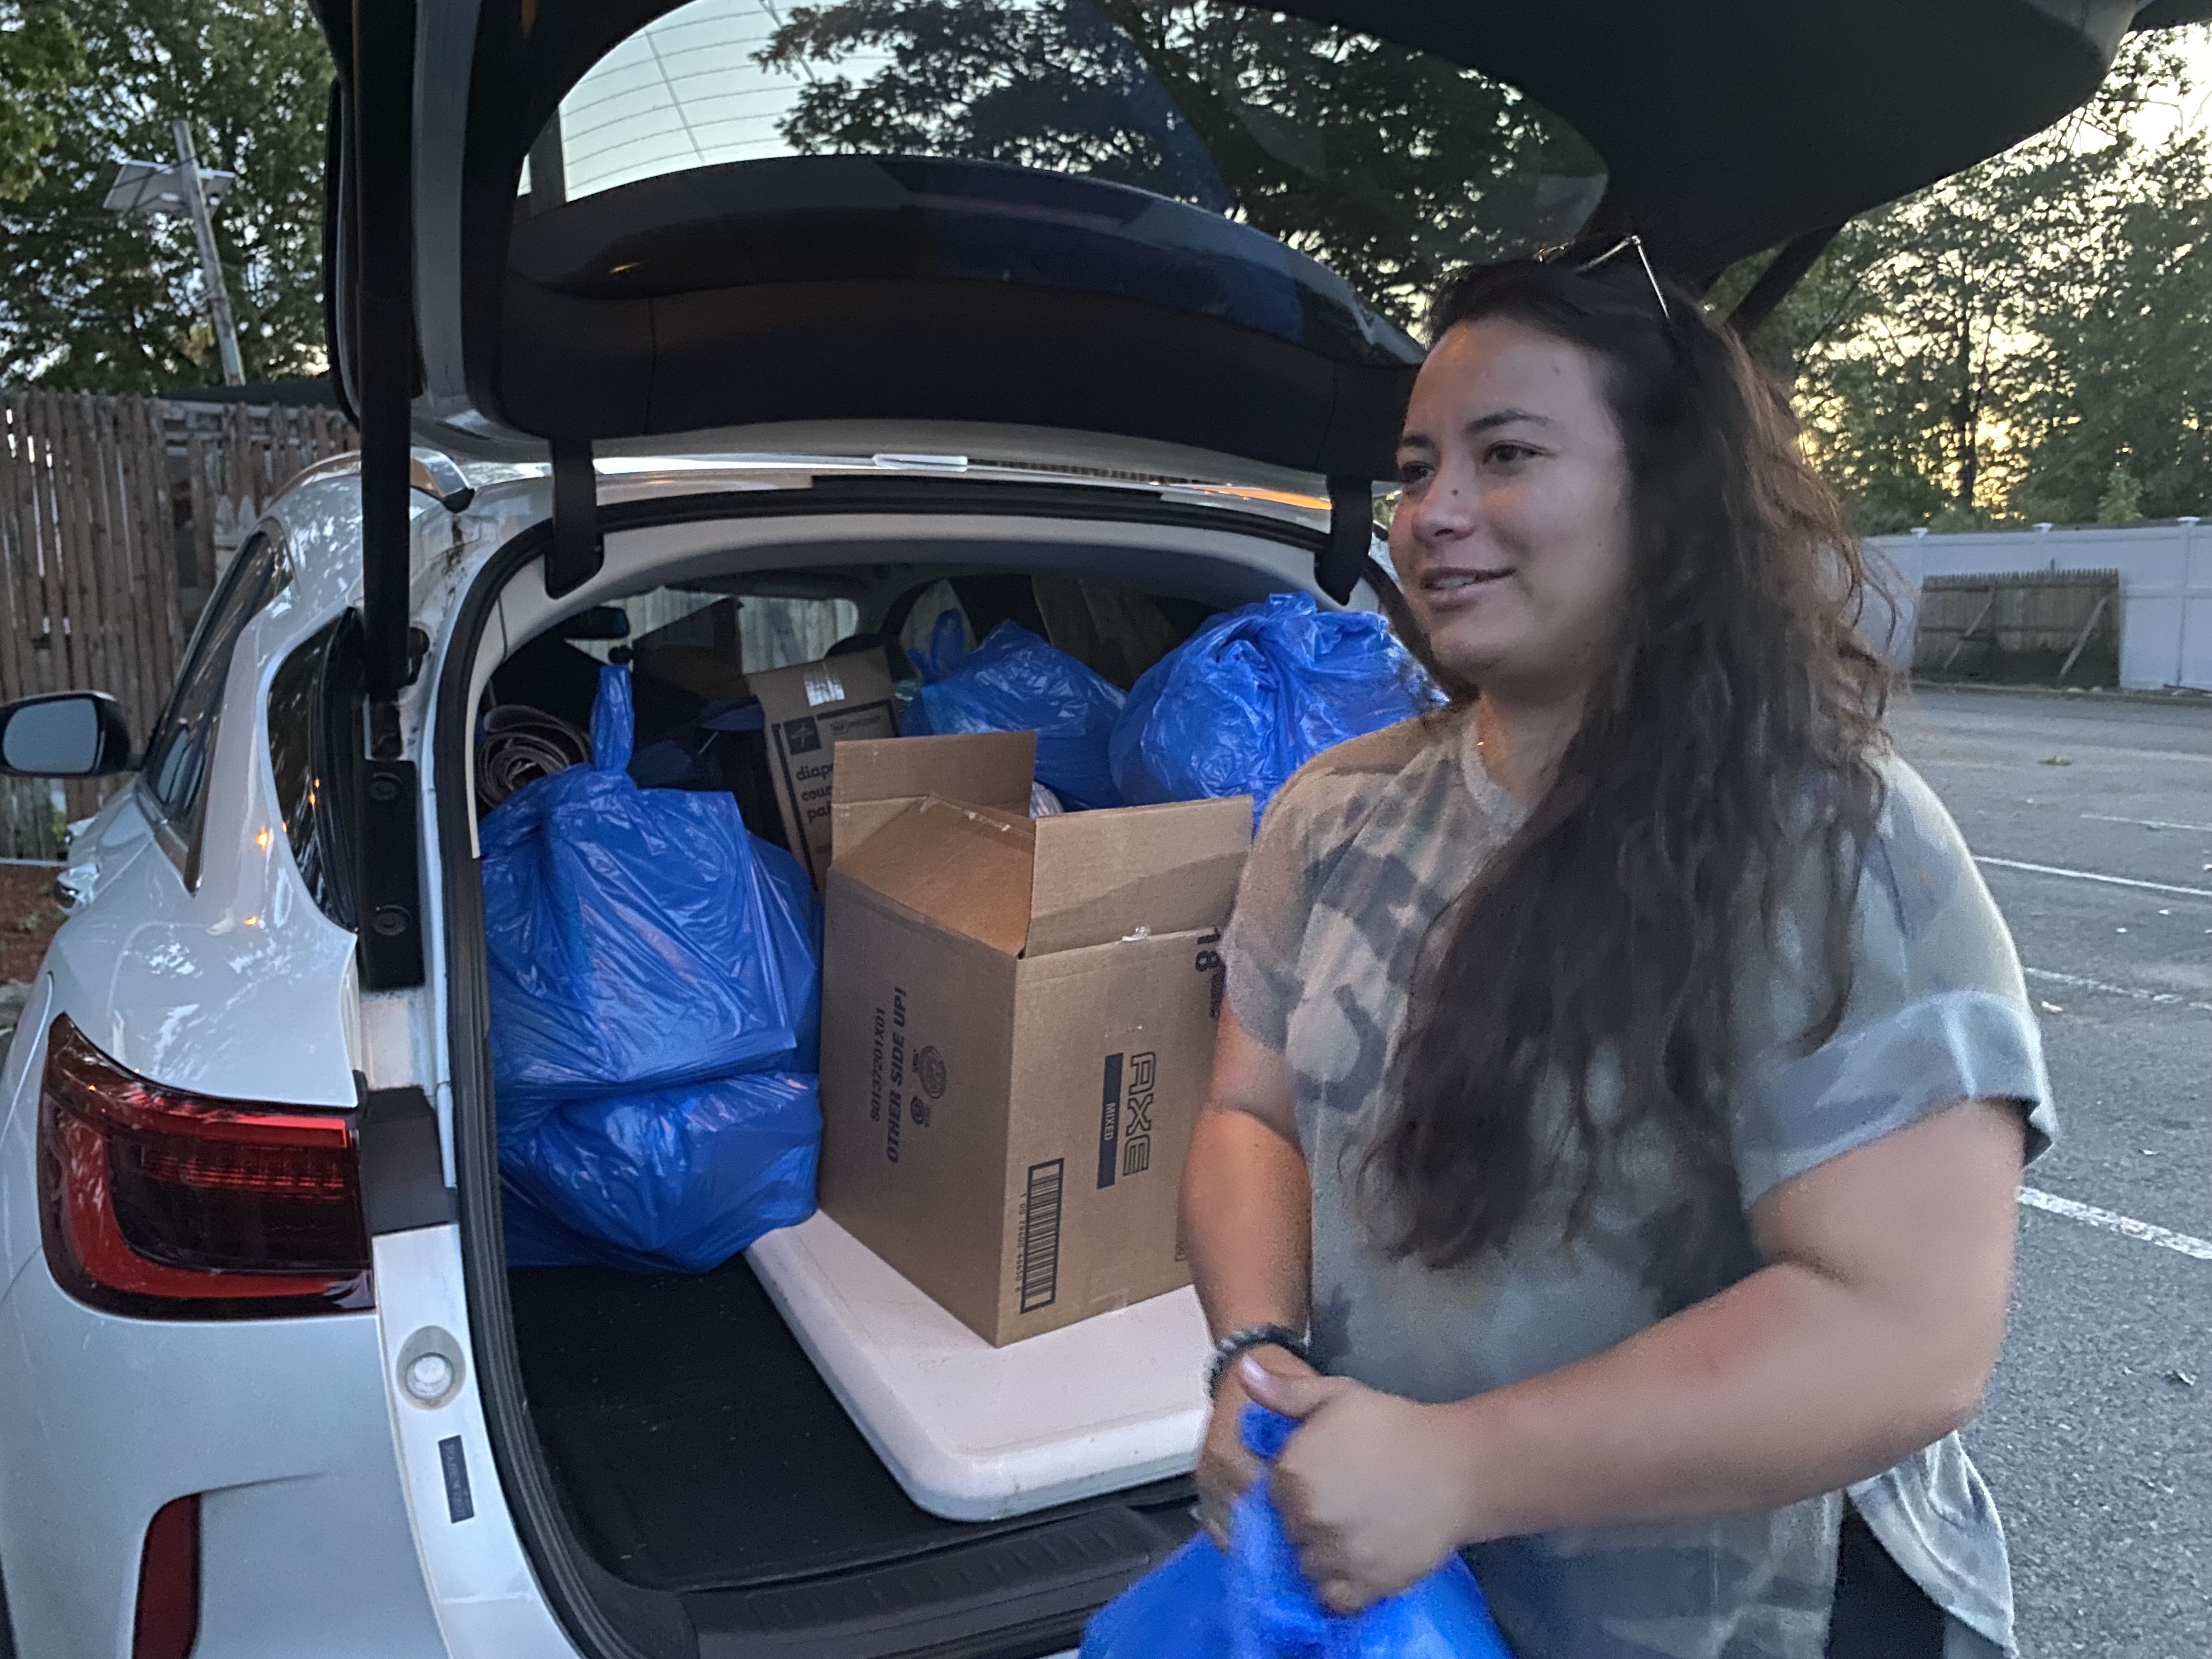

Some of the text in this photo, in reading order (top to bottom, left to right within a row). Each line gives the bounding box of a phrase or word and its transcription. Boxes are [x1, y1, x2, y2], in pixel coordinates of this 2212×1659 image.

[871, 1007, 885, 1122] 80137201X01
[886, 986, 906, 1163] OTHER SIDE UP!
[1104, 1102, 1115, 1141] MIXED
[1123, 1051, 1156, 1176] AXE
